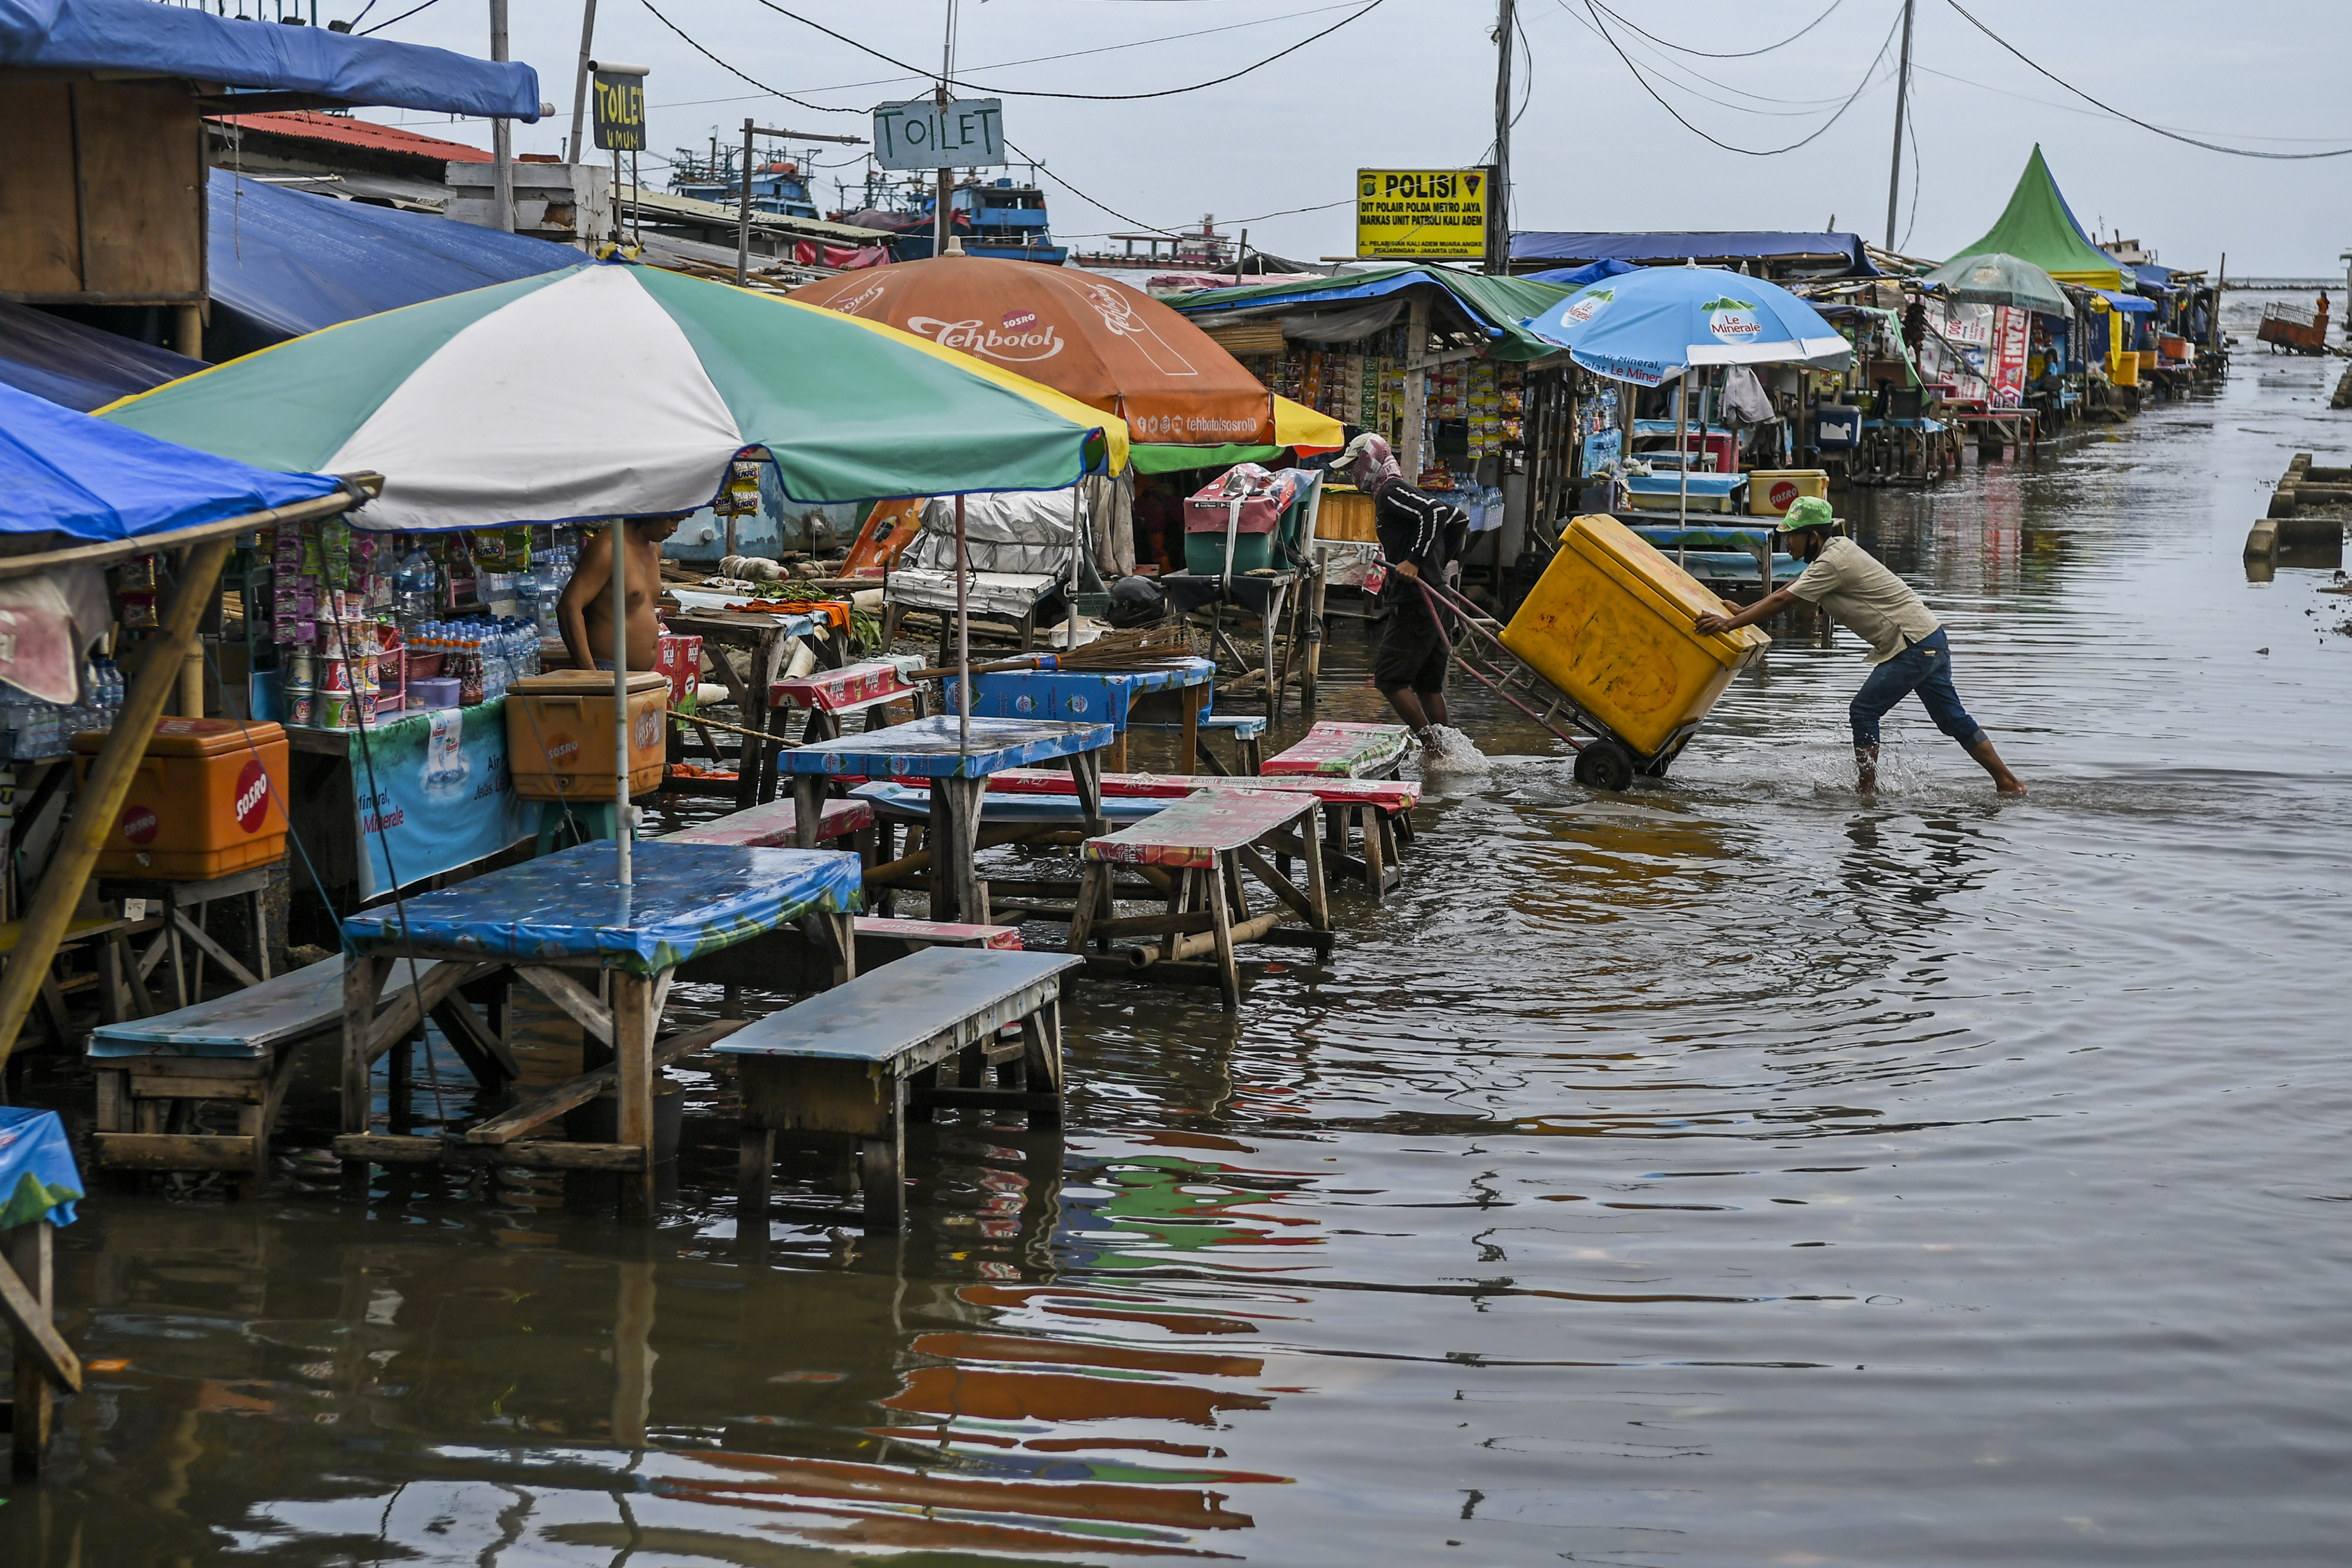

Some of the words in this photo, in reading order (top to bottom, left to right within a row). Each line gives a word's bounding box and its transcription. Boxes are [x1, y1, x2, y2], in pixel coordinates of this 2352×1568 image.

[595, 79, 643, 125] TOILET
[607, 129, 639, 150] UMUM
[875, 109, 1000, 158] TOILET
[1385, 173, 1456, 198] POLISI
[1361, 202, 1374, 212] DIT
[1376, 202, 1404, 212] POLAIR
[1406, 202, 1430, 212] POLDA
[1433, 202, 1459, 212] METRO
[1461, 202, 1481, 212] JAYA
[1360, 215, 1391, 226] MARKAS
[1392, 215, 1409, 226] UNIT
[1412, 215, 1441, 226] PATROLI
[1443, 215, 1460, 226] KALI
[1462, 215, 1482, 226] ADEM
[1003, 313, 1035, 329] SOSRO
[1711, 322, 1761, 333] Minerale
[1724, 315, 1739, 325] Le
[907, 316, 1064, 362] Tehbotol
[1618, 356, 1661, 371] Mineral,
[1611, 363, 1623, 376] Le
[1626, 366, 1662, 383] Miner
[735, 470, 756, 479] SUKRO
[1771, 487, 1798, 504] SOSRO
[735, 500, 755, 509] SUKRO
[548, 741, 579, 759] SOSRO
[487, 754, 500, 771] Air
[236, 773, 267, 821] SOSRO
